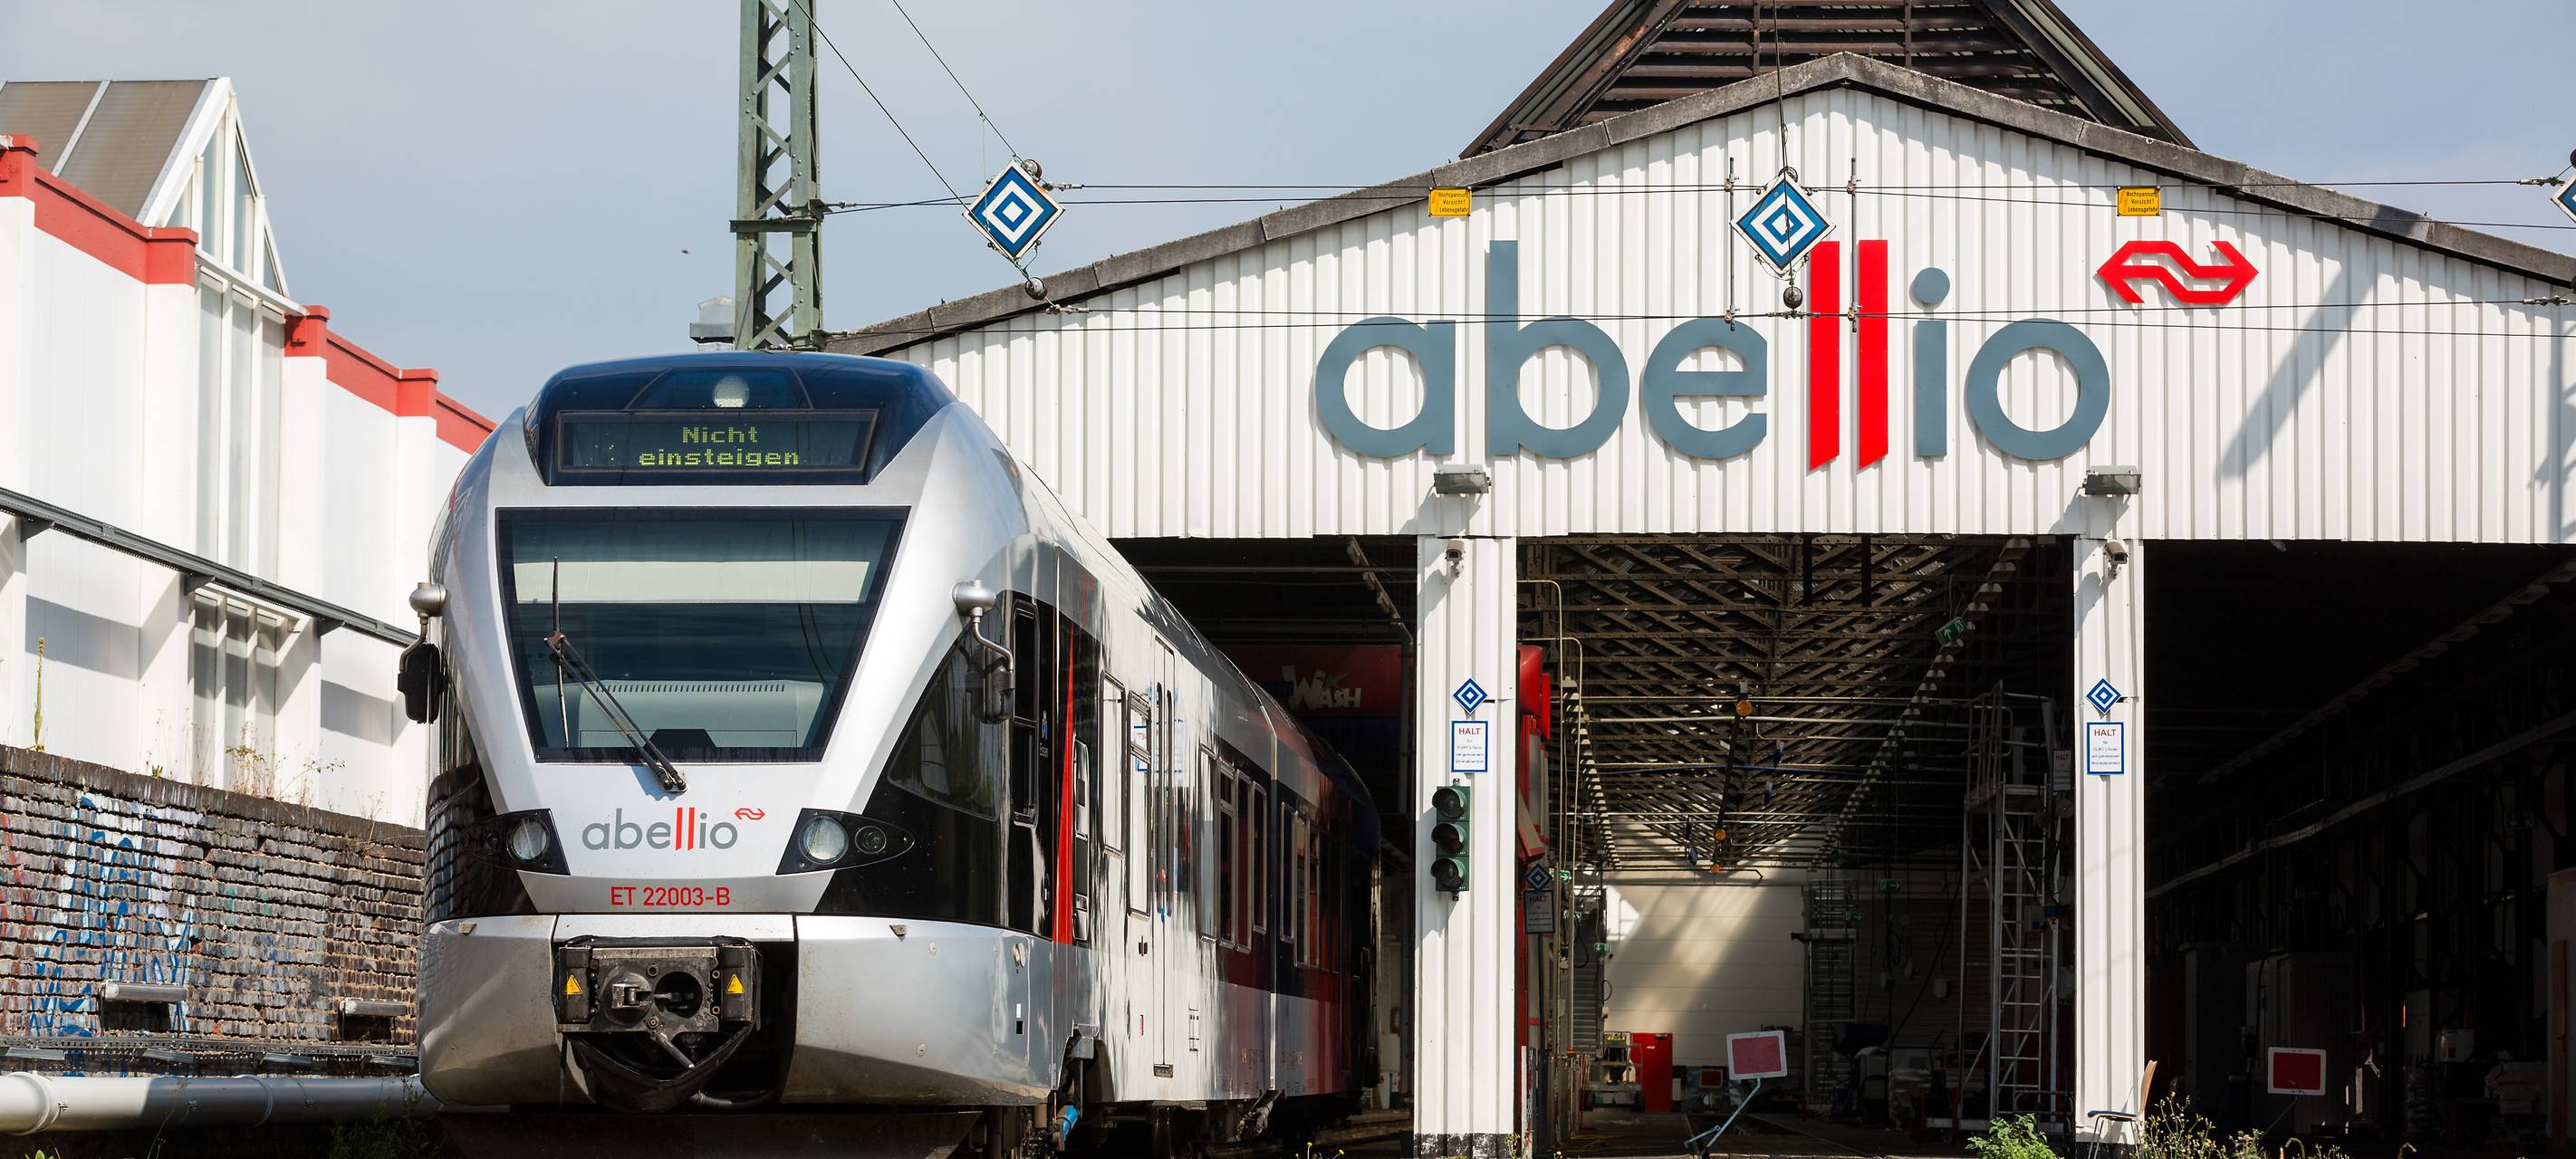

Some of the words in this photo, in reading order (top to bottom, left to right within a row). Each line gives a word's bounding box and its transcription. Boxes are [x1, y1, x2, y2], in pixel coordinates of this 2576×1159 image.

[1315, 239, 2110, 471] abellio
[682, 426, 758, 443] Nicht
[639, 448, 799, 466] einsteigen
[1458, 727, 1481, 735] HALT
[582, 807, 738, 851] abellio
[610, 886, 636, 905] ET
[643, 886, 730, 905] 22003-B
